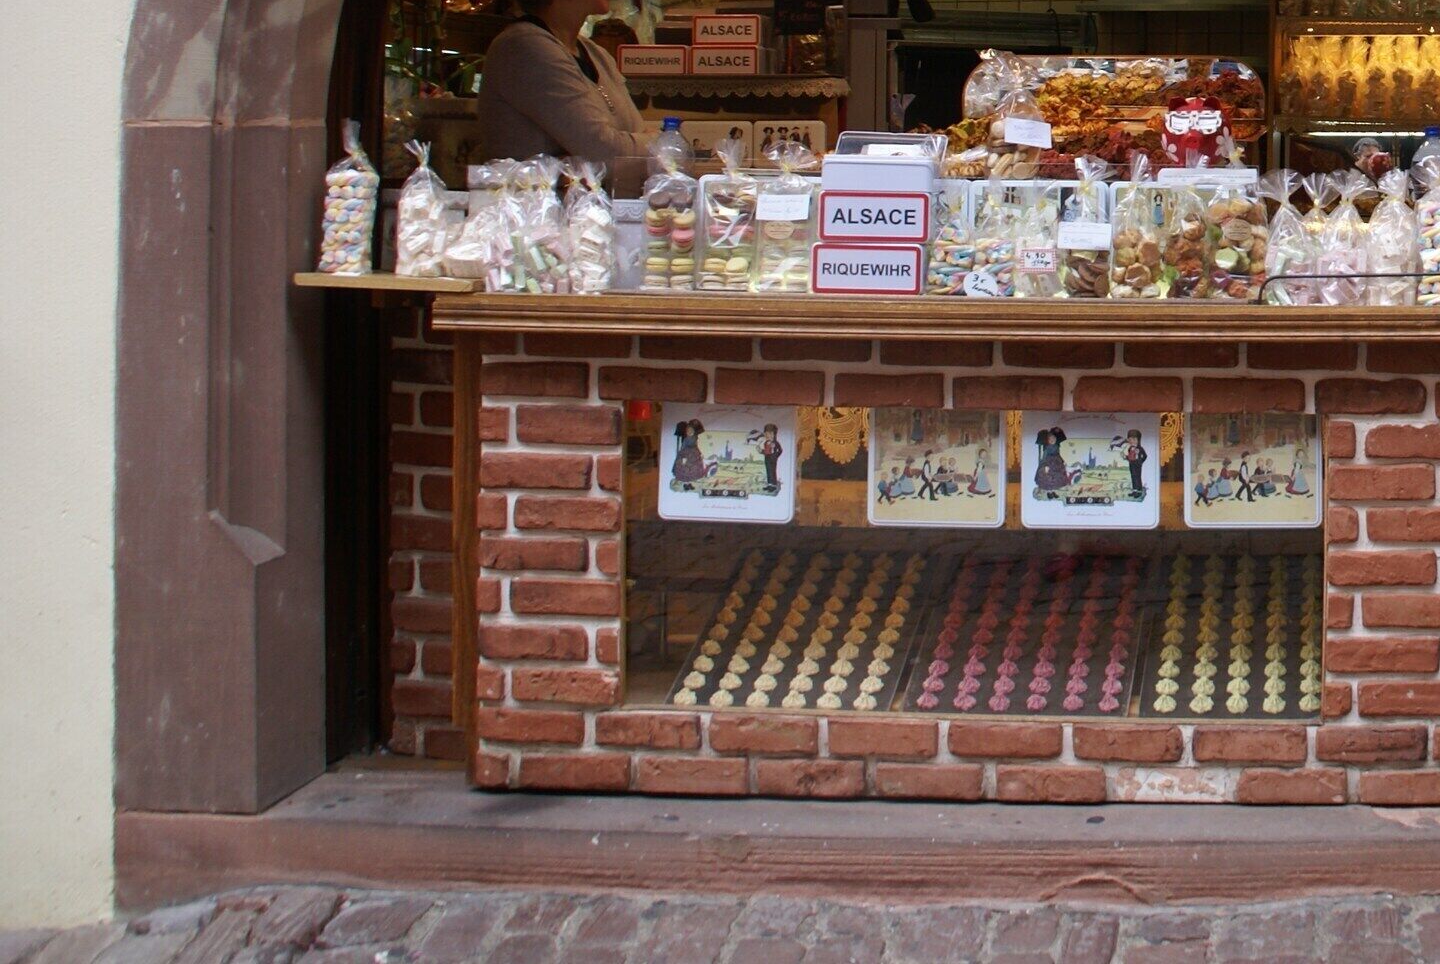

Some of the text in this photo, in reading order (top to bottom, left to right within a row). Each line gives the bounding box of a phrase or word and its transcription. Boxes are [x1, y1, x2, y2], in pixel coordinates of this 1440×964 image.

[700, 24, 753, 37] ALSACE
[623, 56, 682, 66] RIQUEWIHR
[697, 55, 751, 68] ALSACE
[831, 207, 917, 225] ALSACE
[821, 262, 912, 278] RIQUEWIHR
